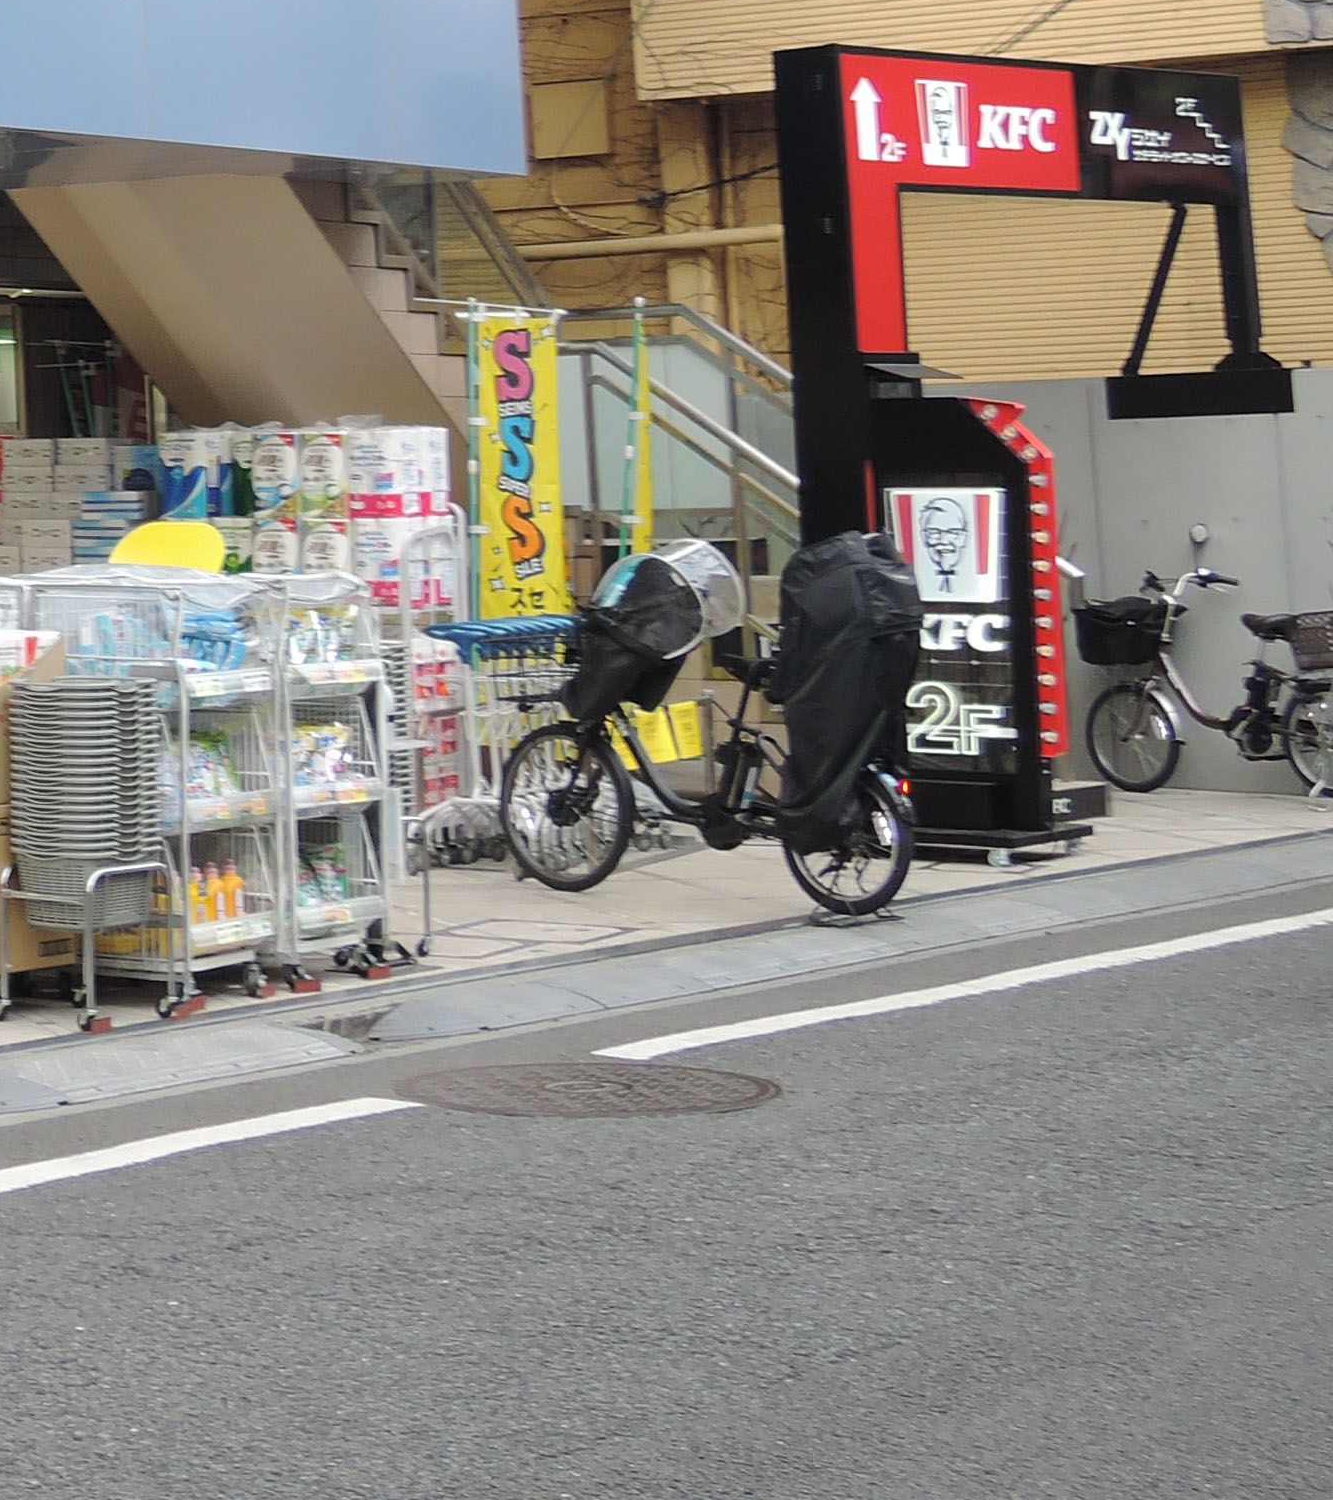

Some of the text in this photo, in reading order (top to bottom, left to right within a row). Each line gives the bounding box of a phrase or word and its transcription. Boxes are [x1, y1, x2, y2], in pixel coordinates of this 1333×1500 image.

[976, 103, 1057, 153] KFC
[494, 328, 534, 402] S
[500, 415, 535, 482] S
[503, 495, 546, 564] S
[904, 680, 1006, 755] 2F
